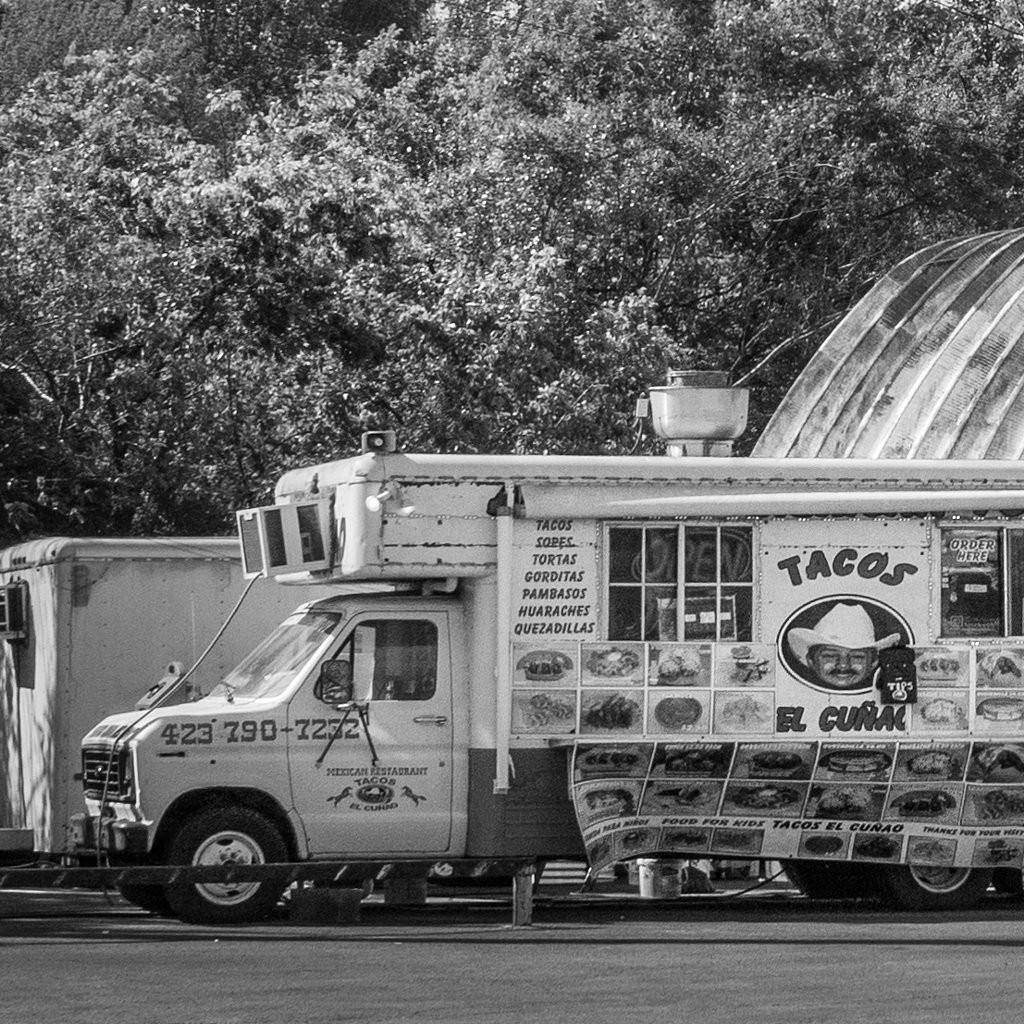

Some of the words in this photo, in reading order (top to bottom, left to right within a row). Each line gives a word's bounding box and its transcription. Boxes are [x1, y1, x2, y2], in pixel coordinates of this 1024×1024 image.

[536, 520, 573, 531] TACOS
[536, 537, 573, 547] SOPES
[951, 539, 996, 551] ORDER
[533, 554, 577, 565] TORTAS
[957, 551, 989, 563] HERE
[777, 548, 918, 586] TACOS
[525, 571, 585, 583] GORDITAS
[522, 588, 587, 600] PAMBASOS
[518, 605, 591, 617] HUARACHES
[514, 622, 595, 636] QUEZADILLAS
[887, 678, 913, 693] TIPS
[776, 706, 807, 732] EL
[160, 723, 213, 745] 423
[327, 767, 368, 776] MEXICAN
[370, 767, 428, 776] RESTAURANT
[353, 777, 396, 786] TACOS
[349, 803, 361, 811] EL
[772, 820, 822, 830] TACOS
[826, 821, 843, 831] EL
[923, 826, 958, 835] THANKS
